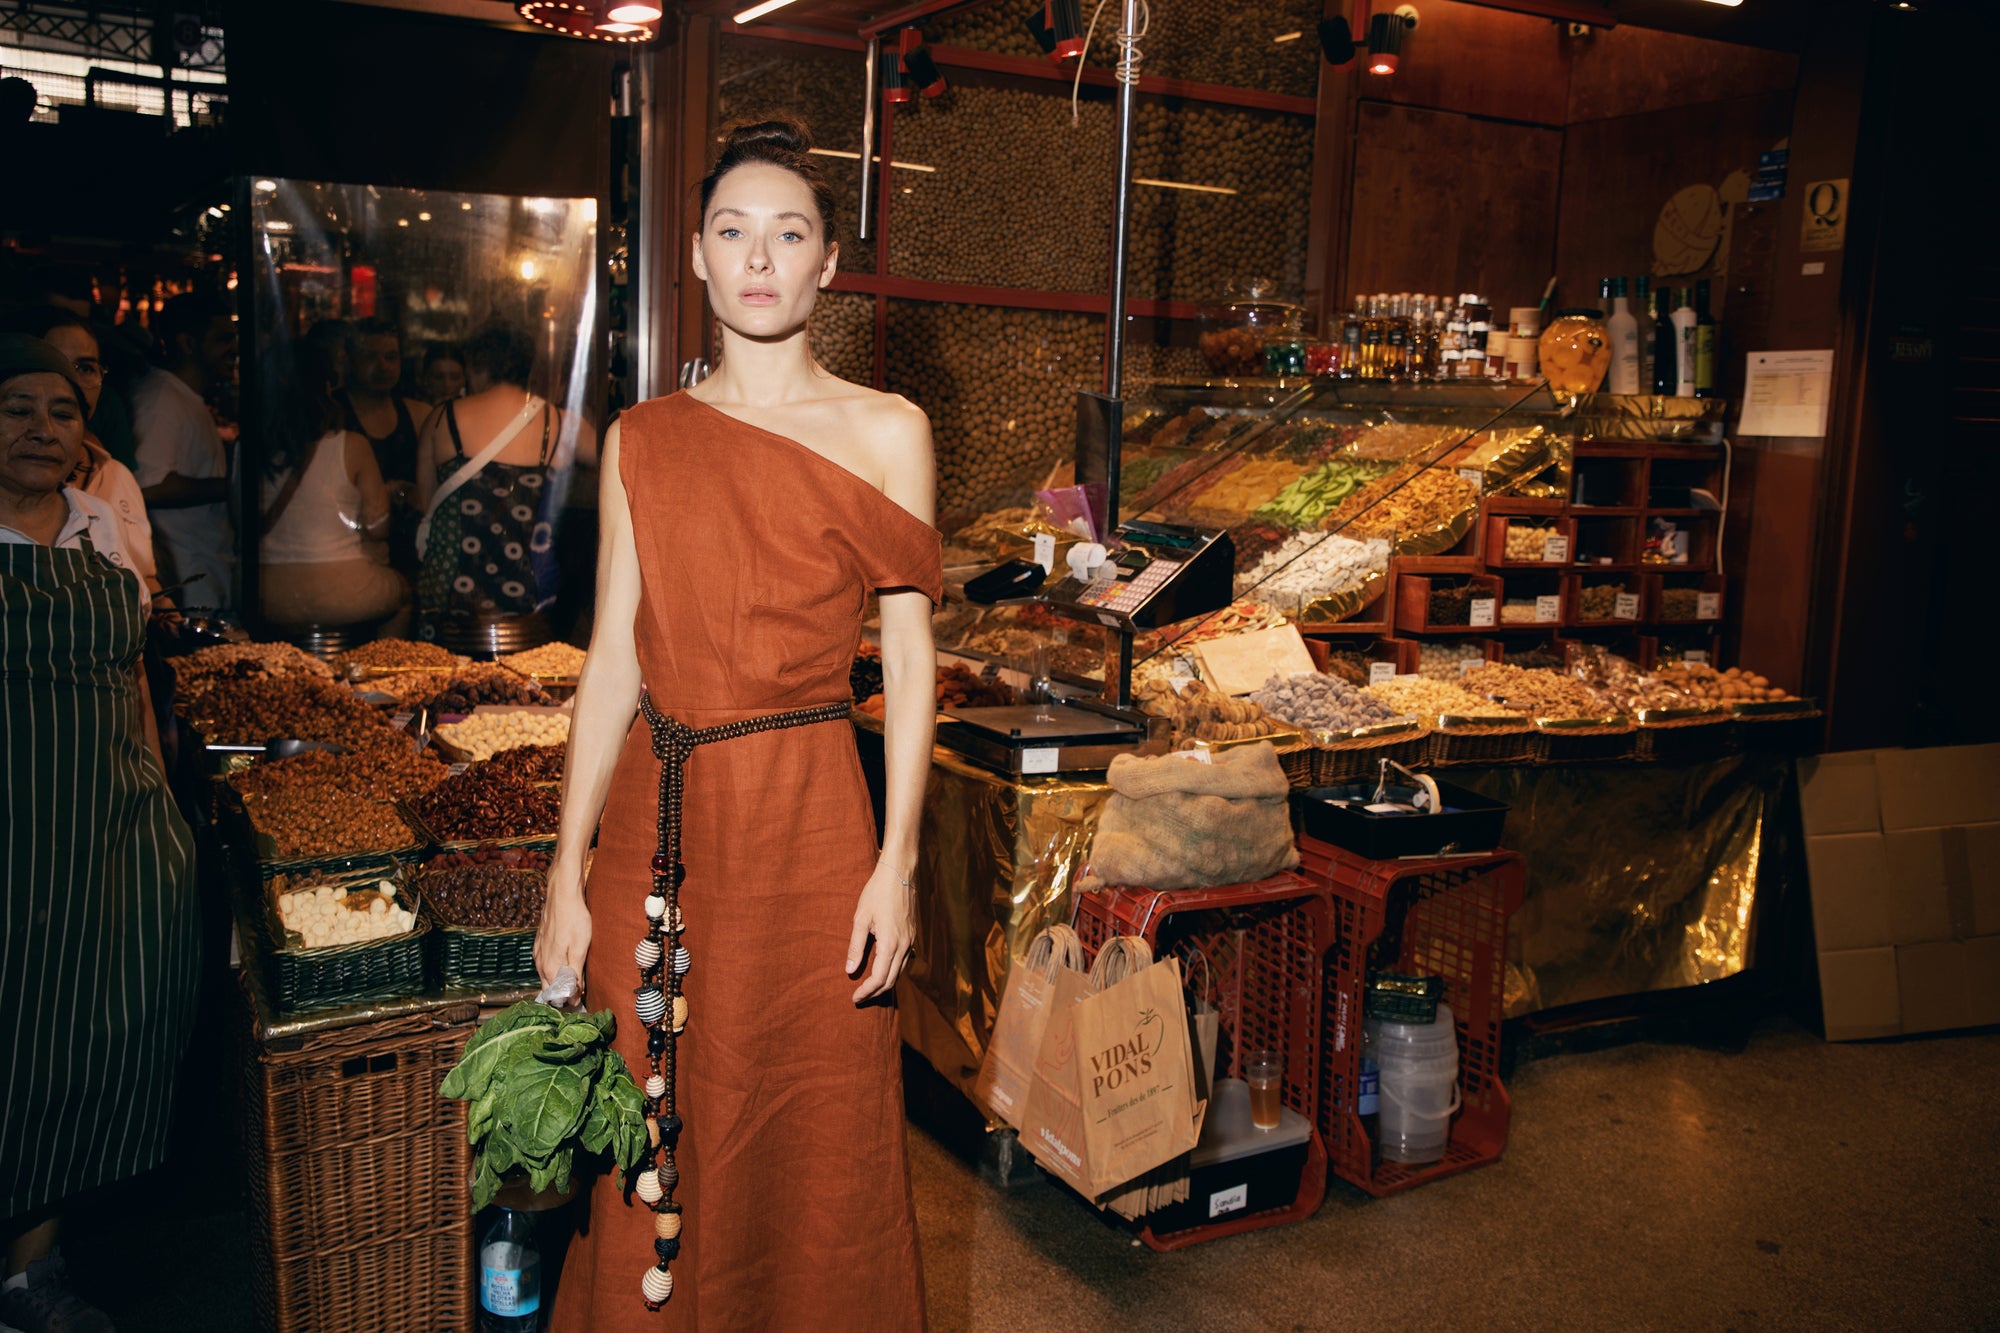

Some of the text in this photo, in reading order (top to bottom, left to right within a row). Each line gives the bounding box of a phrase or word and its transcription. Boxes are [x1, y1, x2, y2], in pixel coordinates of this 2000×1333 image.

[1810, 182, 1840, 226] Q
[1091, 1032, 1150, 1074] VIDAL
[1093, 1052, 1152, 1098] PONS
[1040, 1127, 1082, 1168] vidalpons
